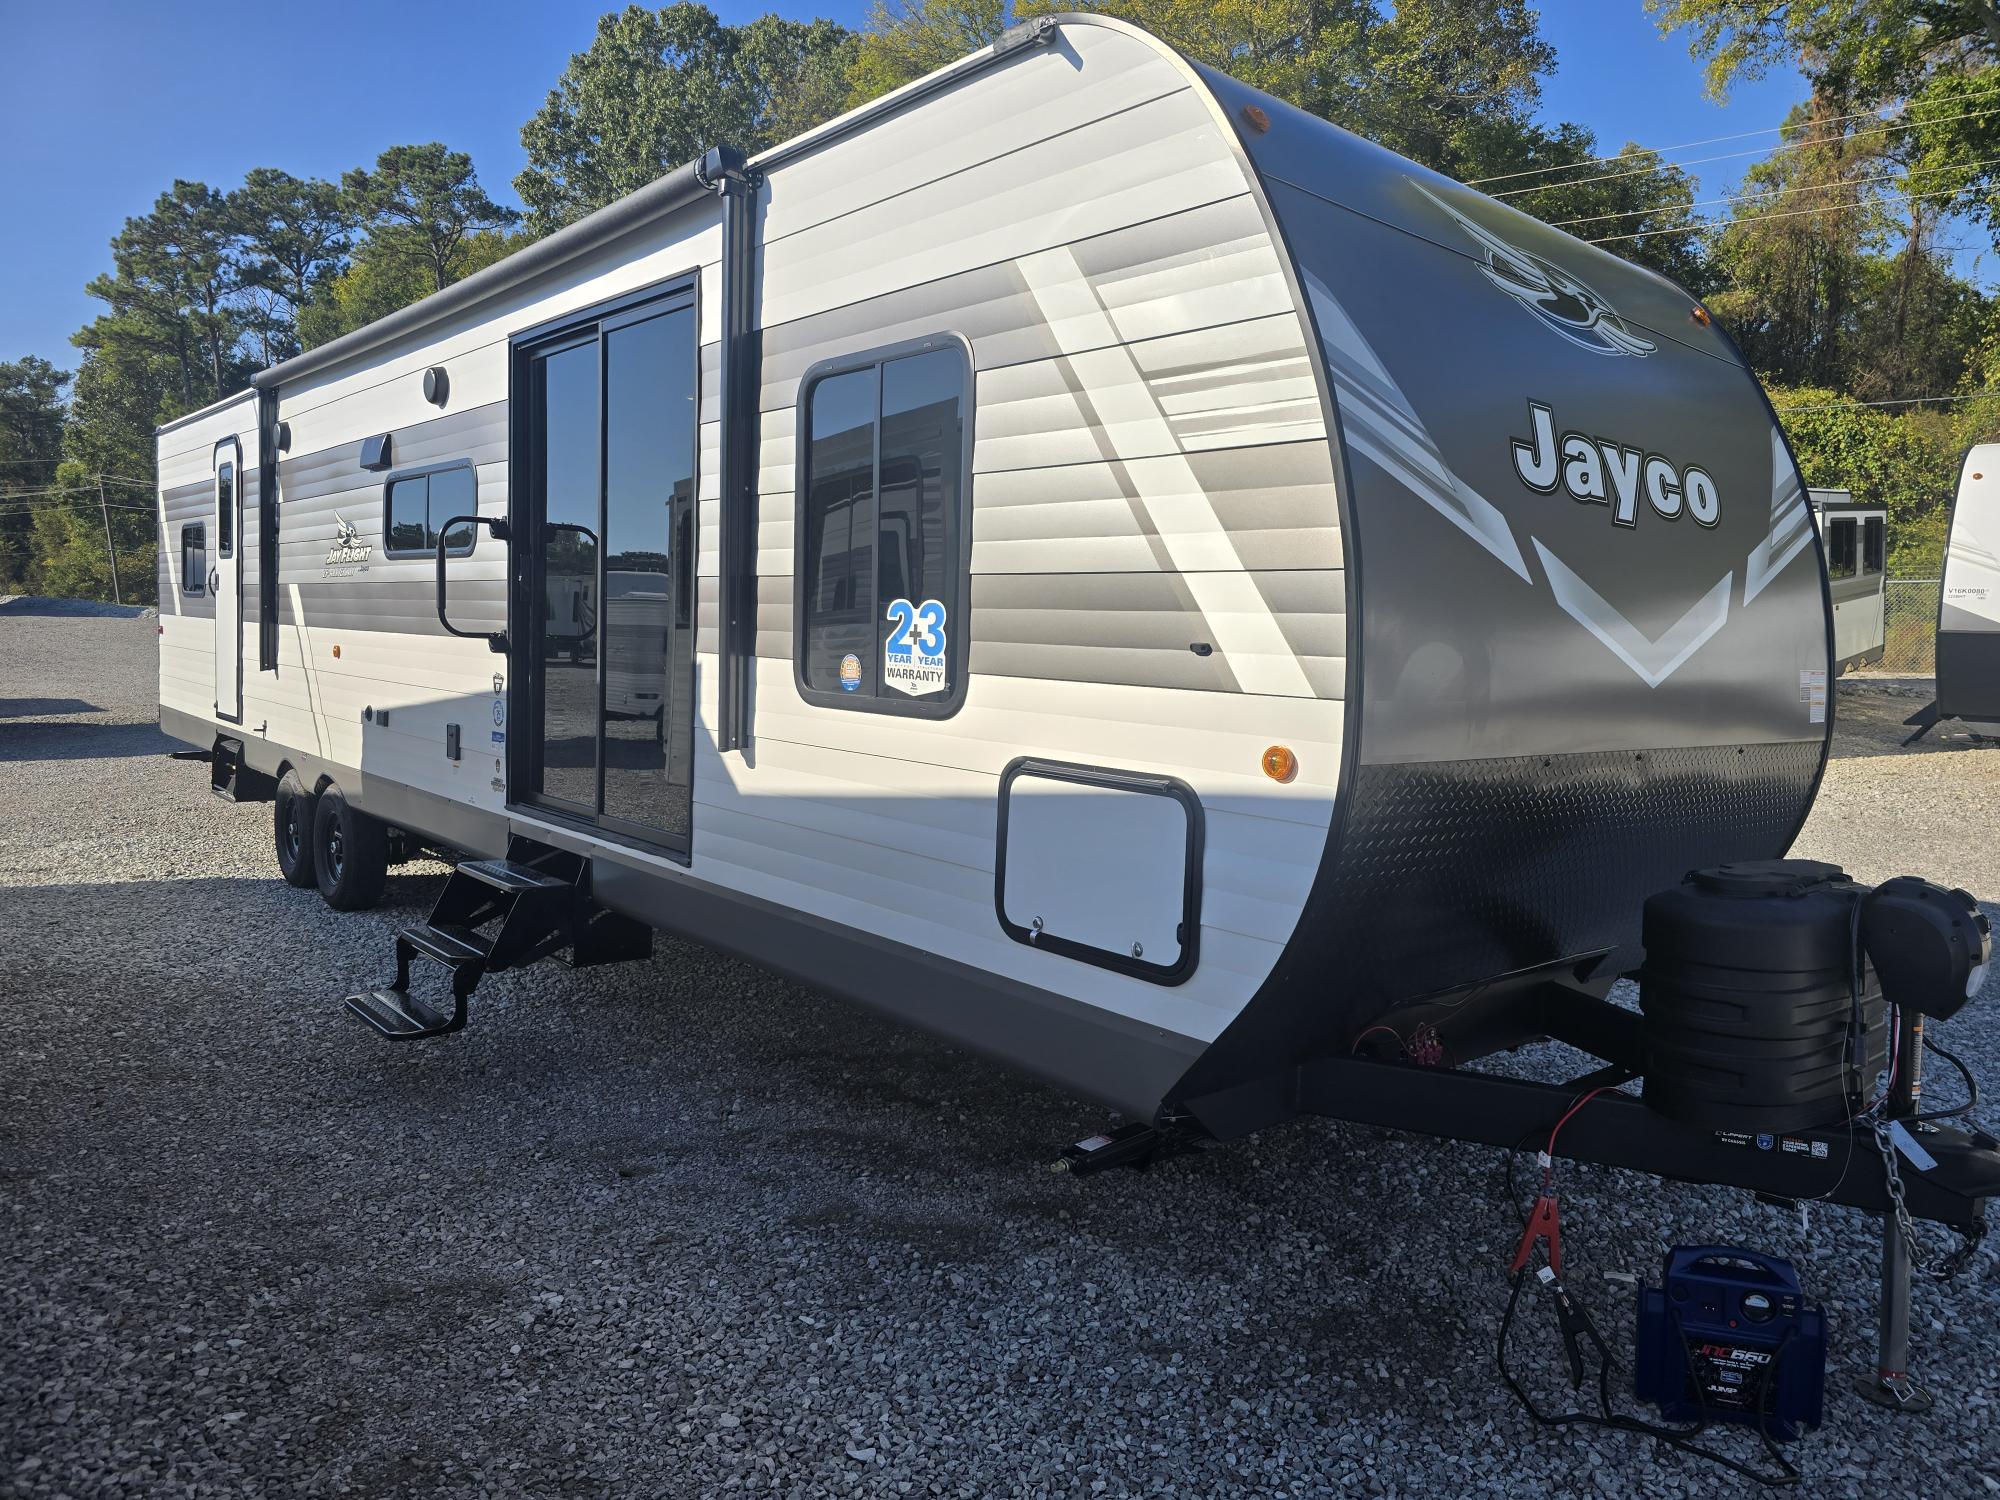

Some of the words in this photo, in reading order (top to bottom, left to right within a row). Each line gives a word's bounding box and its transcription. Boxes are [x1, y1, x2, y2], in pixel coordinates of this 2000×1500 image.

[1509, 397, 1721, 530] Jayco
[326, 547, 343, 565] JAY
[340, 545, 372, 563] FLIGHT
[888, 654, 912, 665] YEAR
[917, 656, 943, 667] YEAR
[887, 667, 943, 682] WARRANTY
